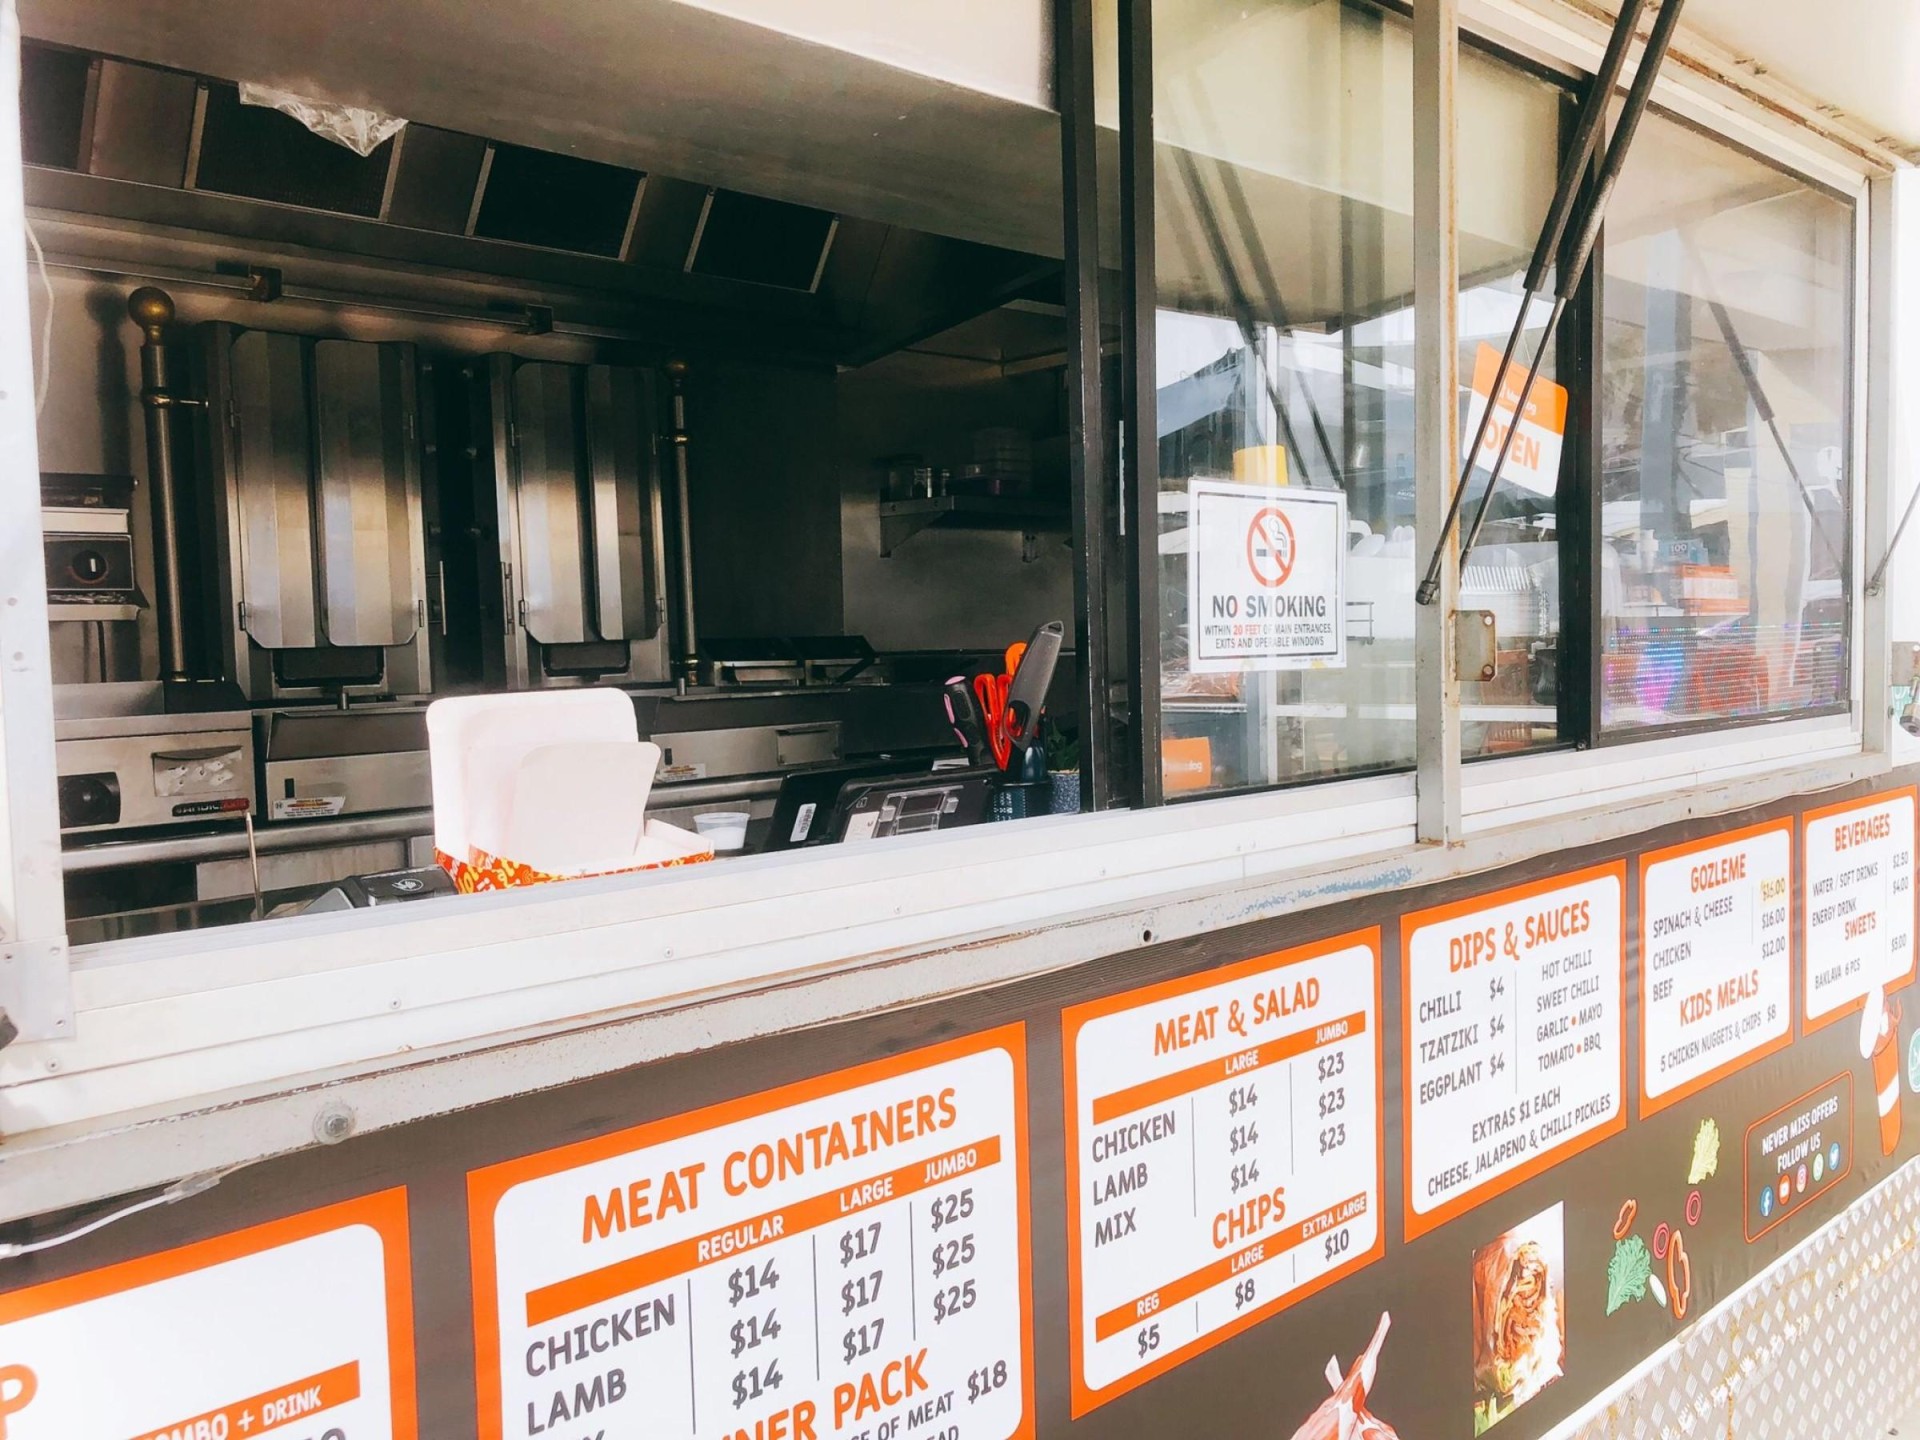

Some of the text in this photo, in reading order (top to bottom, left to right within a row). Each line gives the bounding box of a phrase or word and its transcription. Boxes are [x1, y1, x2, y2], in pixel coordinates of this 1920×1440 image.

[1205, 625, 1230, 636] WITHIN
[1233, 625, 1243, 635] 20
[1245, 625, 1260, 635] FEET
[1263, 624, 1272, 634] OF
[1275, 624, 1291, 634] MAIN
[1213, 596, 1325, 618] NO SMOKING
[1216, 638, 1235, 649] EXITS
[1238, 638, 1252, 648] AND
[1292, 636, 1323, 646] WINDOWS
[1835, 813, 1890, 852] BEVERAGES
[1691, 854, 1746, 893] GOZLEME
[1812, 878, 1833, 897] WATER
[1840, 870, 1854, 888] SOFT
[1856, 862, 1878, 882] DRINKS
[1812, 876, 1908, 927] ENERGY DRINK $4.00
[1450, 901, 1590, 973] DIPS & SAUCES
[1653, 912, 1691, 938] SPINACH
[1695, 909, 1701, 927] &
[1704, 896, 1733, 921] CHEESE
[1653, 907, 1785, 971] CHICKEN $16.00
[1845, 911, 1876, 940] SWEETS
[1542, 950, 1592, 981] HOT CHILLI
[1653, 936, 1785, 1001] BEEF $12.00
[1815, 965, 1841, 989] BAKLAVA
[1154, 978, 1319, 1056] MEAT & SALAD
[1420, 977, 1504, 1024] CHILLI $4
[1537, 976, 1599, 1013] SWEET CHILLI
[1537, 1003, 1602, 1042] GARLIC MAYO
[1680, 970, 1759, 1027] KIDS MEALS
[1226, 1021, 1348, 1075] LARGE JUMBO
[1420, 1015, 1505, 1064] TZATZIKI $4
[1538, 1033, 1601, 1072] TOMATO BBQ
[1661, 1004, 1776, 1072] 5 CHICKEN NUGGETS & CHIPS $8
[1420, 1052, 1505, 1104] EGGPLANT $4
[1092, 1052, 1344, 1163] CHICKEN $14 $23
[1473, 1086, 1560, 1143] EXTRAS $1 EACH
[1762, 1096, 1838, 1156] NEVER MISS OFFERS
[583, 1087, 956, 1243] MEAT CONTAINERS
[1093, 1089, 1345, 1205] LAMB $14 $23
[1428, 1093, 1611, 1197] CHEESE, JALAPENO & CHILLI PICKLES
[1777, 1132, 1821, 1174] FOLLOW US
[698, 1149, 977, 1262] REGULAR LARGE JUMBO
[1095, 1124, 1345, 1248] MIX $14 $23
[1213, 1187, 1286, 1249] CHIPS
[527, 1189, 974, 1378] CHICKEN $14 $17 $25
[1137, 1196, 1365, 1318] REG LARGE EXTRA LARGE
[1138, 1229, 1349, 1358] $5 $8 $10
[528, 1234, 975, 1436] LAMB $14 $17 $25
[732, 1280, 977, 1408] $14 $17 $25
[237, 1409, 254, 1432] +
[262, 1385, 322, 1427] DRINK
[833, 1349, 928, 1430] PACK
[878, 1361, 1008, 1440] OF MEAT $18
